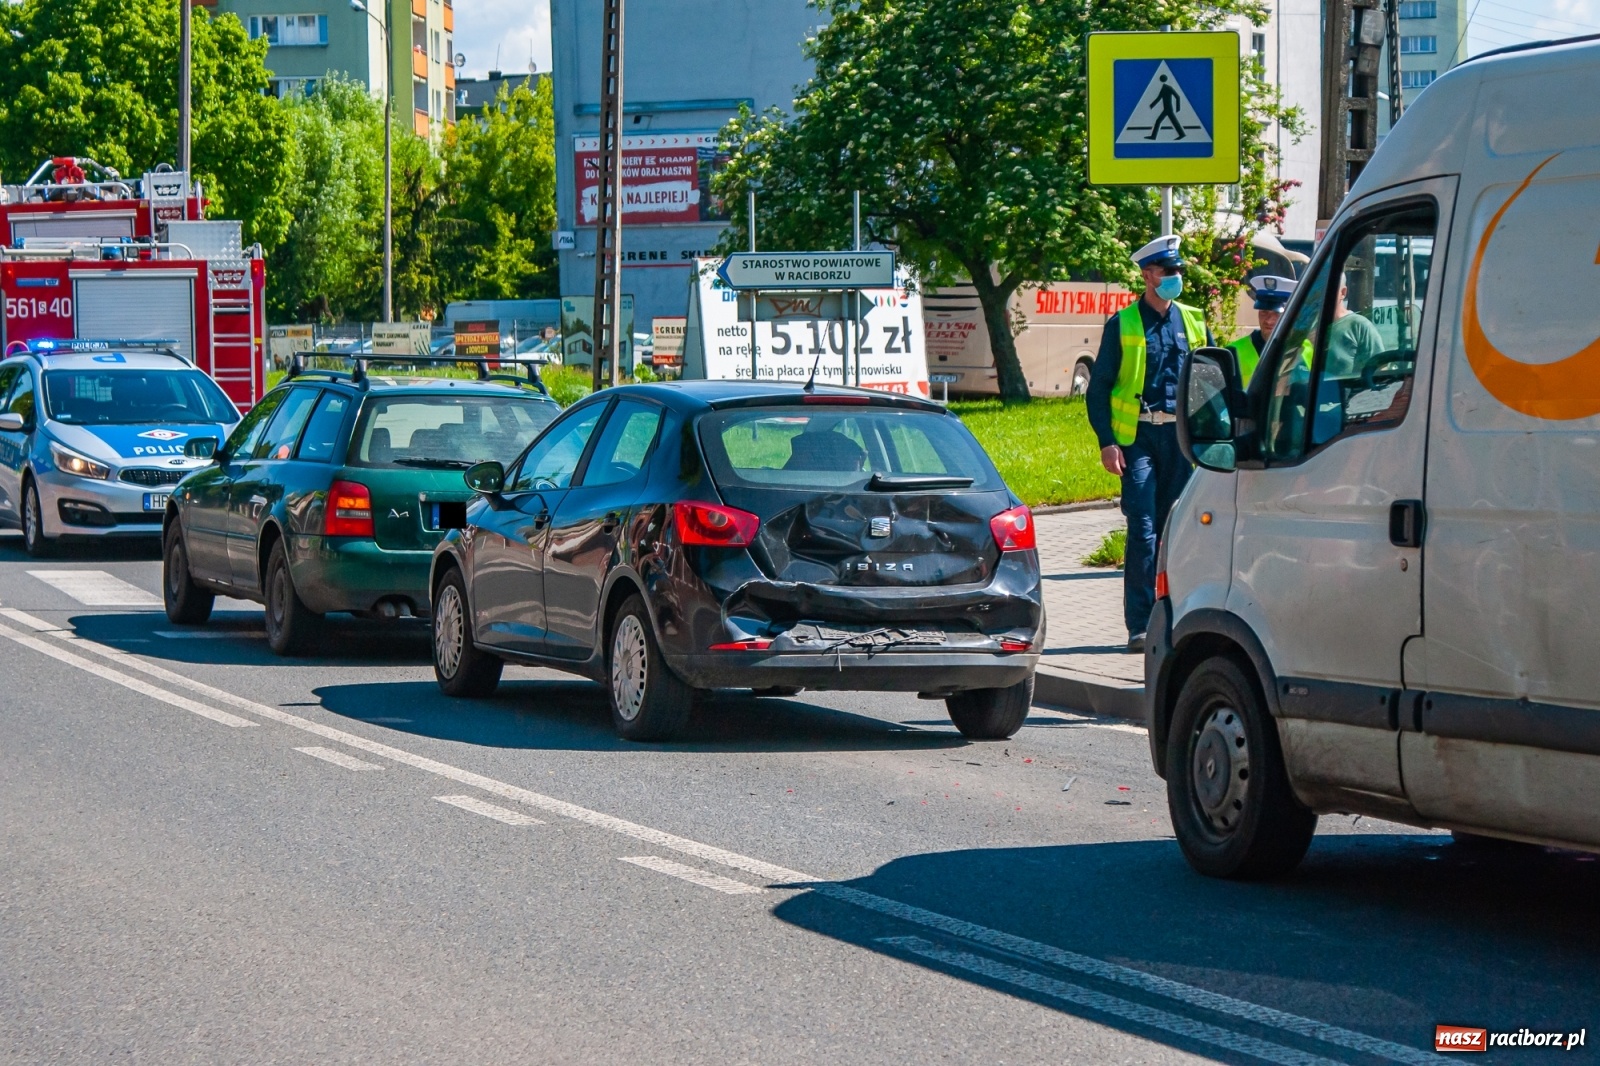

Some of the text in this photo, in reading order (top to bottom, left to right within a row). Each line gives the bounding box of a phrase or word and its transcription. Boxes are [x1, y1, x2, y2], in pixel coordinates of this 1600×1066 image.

[585, 169, 595, 179] DO
[641, 167, 660, 177] ORAZ
[662, 166, 692, 176] MASZYN
[627, 190, 689, 205] NAJLEPIEJ!
[742, 257, 881, 269] STAROSTWO POWIATOWE
[775, 270, 851, 281] W RACIBORZU
[6, 298, 37, 318] 561
[49, 297, 72, 318] 40
[1036, 290, 1139, 315] SOŁTYSIK REISE
[717, 325, 748, 337] netto
[771, 316, 912, 355] 5.102 zł
[719, 345, 732, 356] na
[735, 364, 774, 377] śrenia
[777, 364, 804, 380] płaca
[823, 365, 842, 378] tym
[133, 444, 185, 456] POLIC
[846, 562, 914, 571] IBIZA
